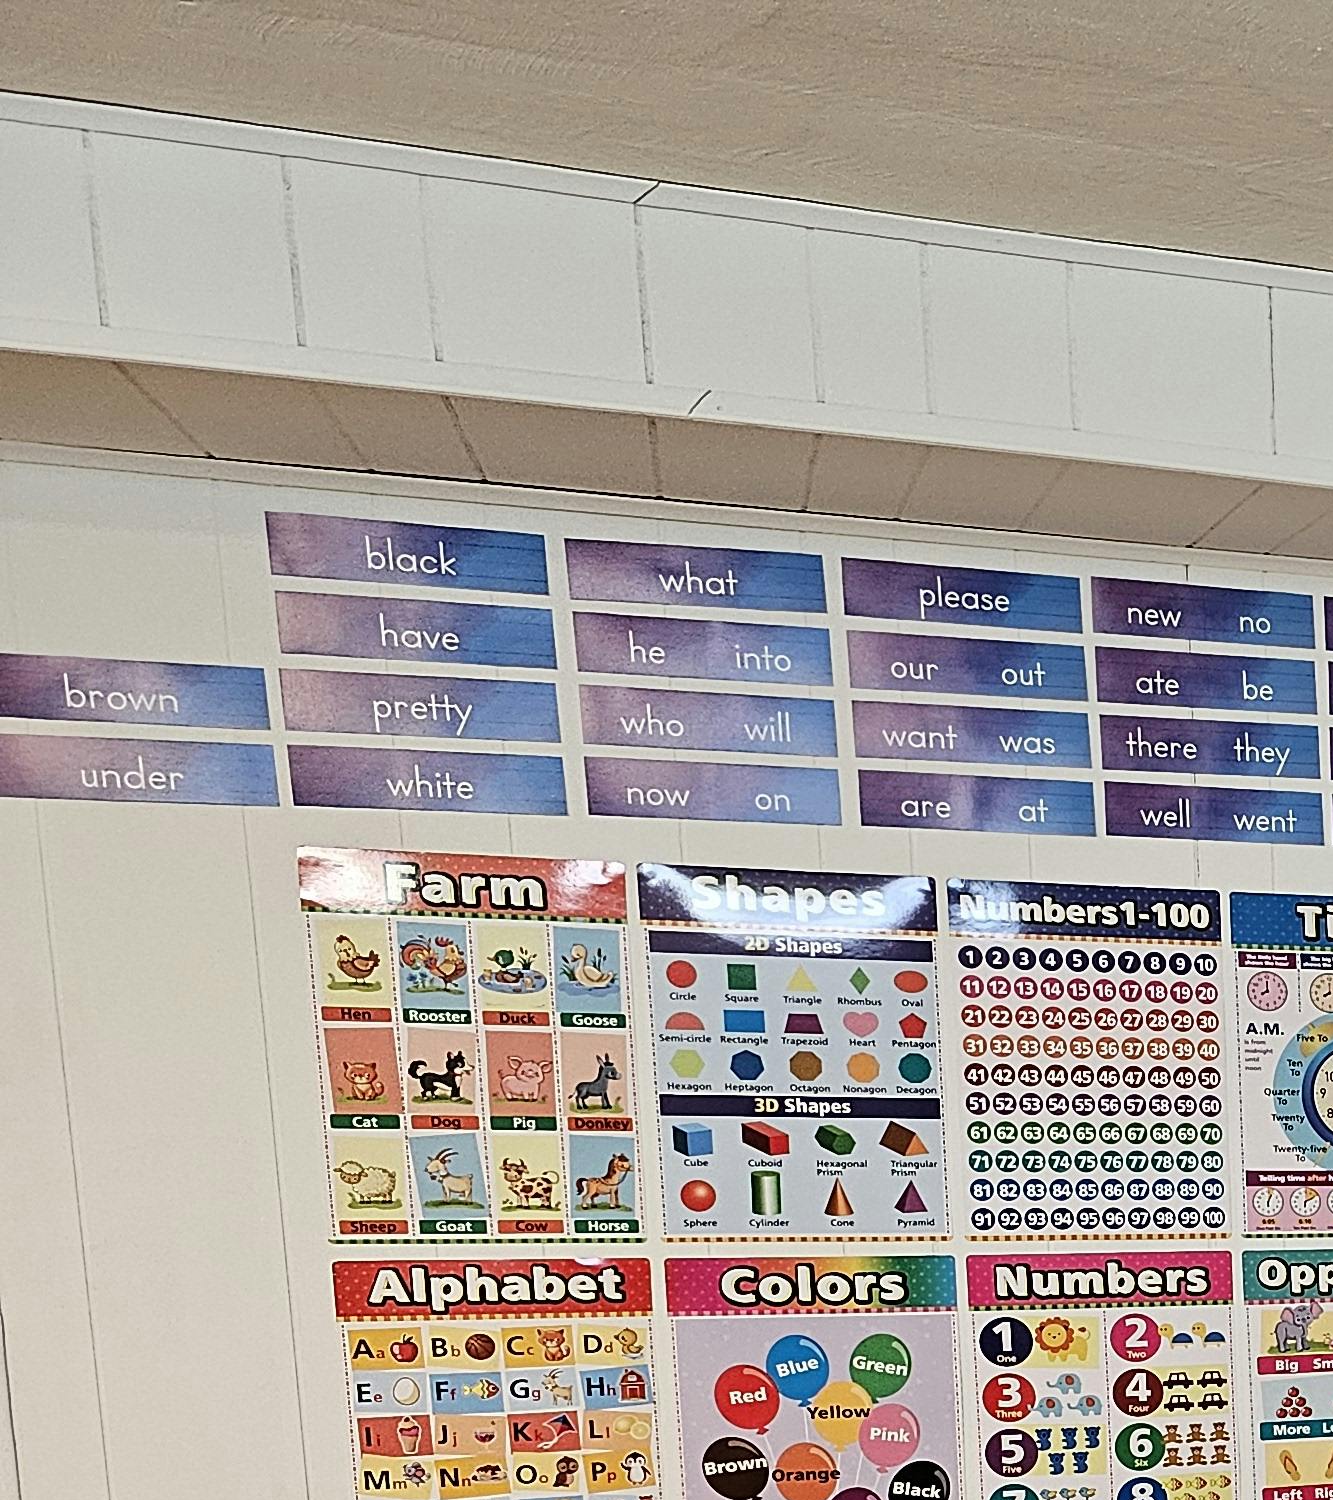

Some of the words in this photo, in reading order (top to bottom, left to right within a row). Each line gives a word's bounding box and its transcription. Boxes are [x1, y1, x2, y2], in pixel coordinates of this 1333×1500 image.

[365, 536, 457, 578] black
[659, 569, 738, 598] what
[919, 585, 1009, 617] please
[1127, 601, 1181, 628] new
[380, 613, 459, 650] have
[1240, 617, 1270, 633] no
[734, 644, 791, 671] into
[891, 662, 938, 680] our
[1002, 663, 1045, 686] out
[64, 673, 178, 712] brown
[1136, 671, 1179, 695] ate
[1242, 675, 1273, 703] be
[373, 692, 472, 735] pretty
[620, 711, 684, 738] who
[744, 711, 790, 742] will
[882, 725, 957, 749] want
[999, 736, 1055, 754] was
[1126, 732, 1197, 761] there
[1234, 738, 1290, 775] they
[81, 763, 184, 791] under
[387, 771, 474, 800] white
[627, 788, 689, 806] now
[901, 801, 951, 818] are
[1019, 799, 1048, 822] at
[1140, 798, 1190, 827] well
[1234, 810, 1297, 832] went
[384, 862, 546, 908] Farm
[691, 875, 886, 922] Shapes
[745, 936, 769, 950] 2D
[775, 938, 843, 956] Shapes
[1200, 958, 1213, 972] 10
[725, 993, 759, 1003] Square
[783, 995, 822, 1005] Triangle
[409, 1010, 467, 1023] Rooster
[572, 1014, 618, 1026] Goose
[1246, 1023, 1285, 1035] A.M.
[754, 1099, 779, 1112] 3D
[785, 1099, 851, 1117] Shapes
[352, 1117, 378, 1128] Cat
[513, 1118, 535, 1130] Pig
[684, 1159, 708, 1167] Cube
[436, 1221, 472, 1232] Goat
[588, 1221, 629, 1232] Horse
[1206, 1212, 1223, 1224] 100
[369, 1266, 624, 1312] Alphabet
[722, 1265, 904, 1303] Colors
[995, 1262, 1208, 1296] Numbers
[1125, 1318, 1148, 1348] 2
[776, 1358, 819, 1377] Blue
[852, 1356, 908, 1376] Green
[1276, 1360, 1298, 1372] Big
[729, 1388, 767, 1404] Red
[807, 1406, 870, 1420] Yellow
[1274, 1425, 1310, 1435] More
[704, 1457, 768, 1476] Brown
[772, 1469, 840, 1483] Orange
[892, 1482, 942, 1499] Black
